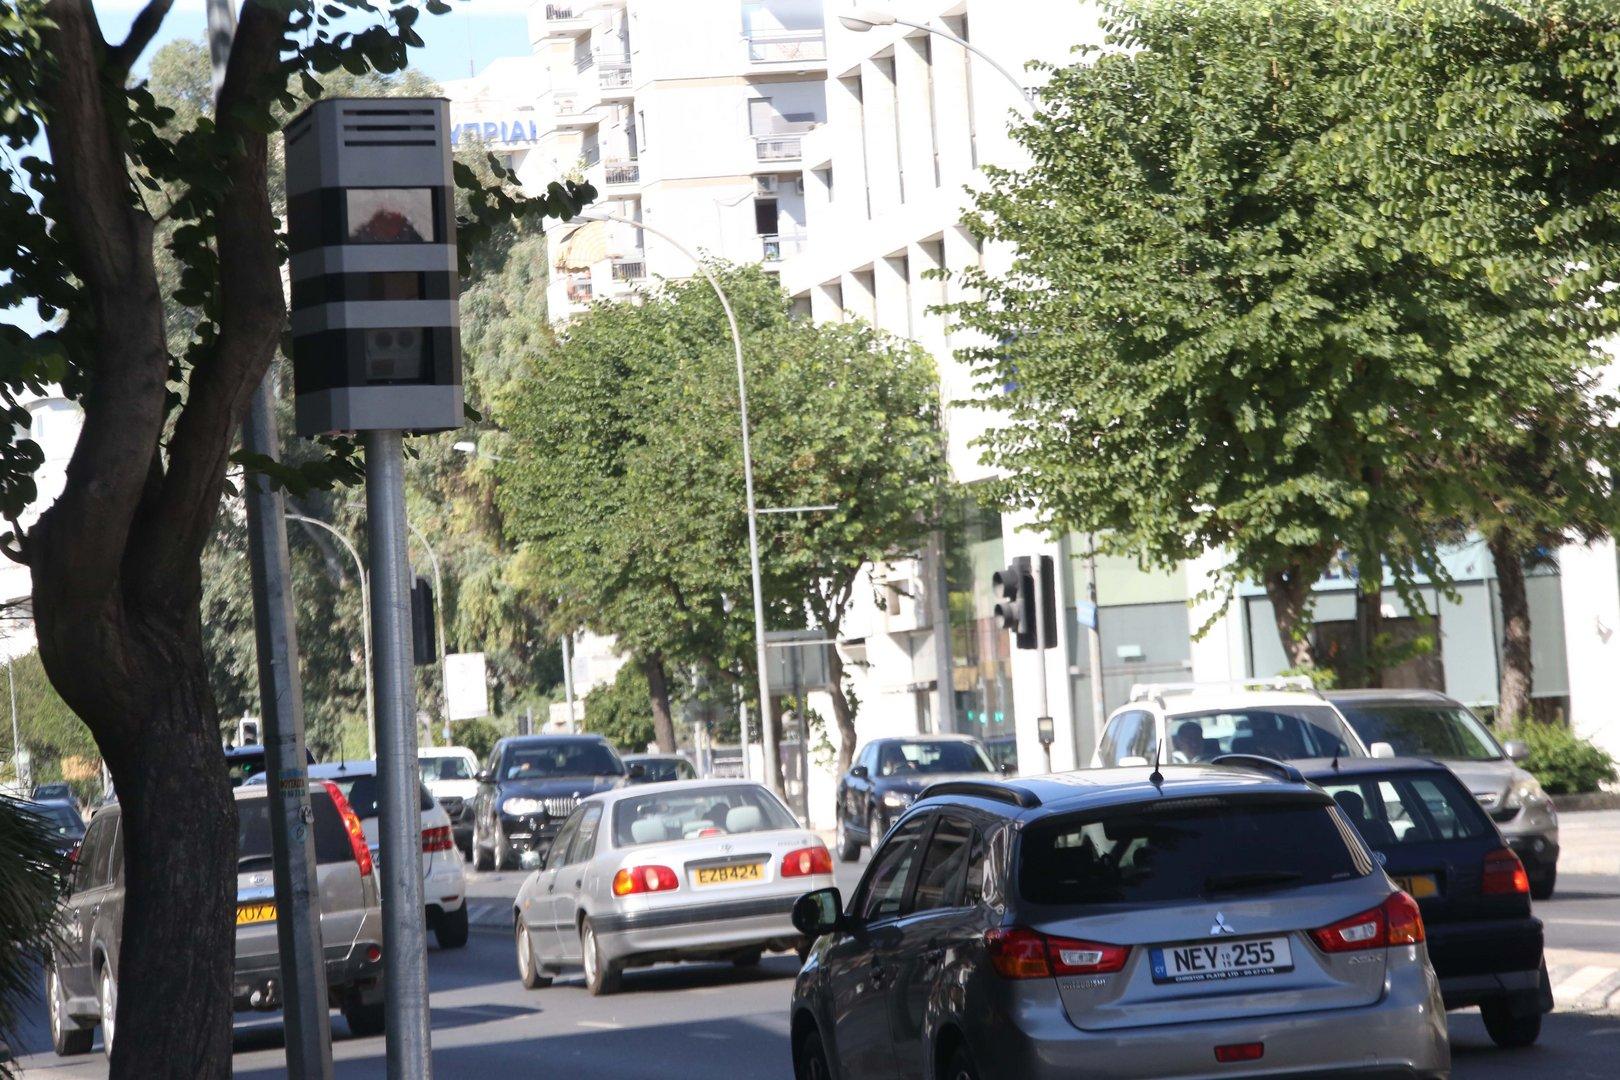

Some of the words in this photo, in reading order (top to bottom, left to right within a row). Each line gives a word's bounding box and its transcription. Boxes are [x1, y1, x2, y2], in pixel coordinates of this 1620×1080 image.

[698, 864, 758, 883] EZB424
[1174, 946, 1217, 972] NEY
[1232, 941, 1275, 966] 255
